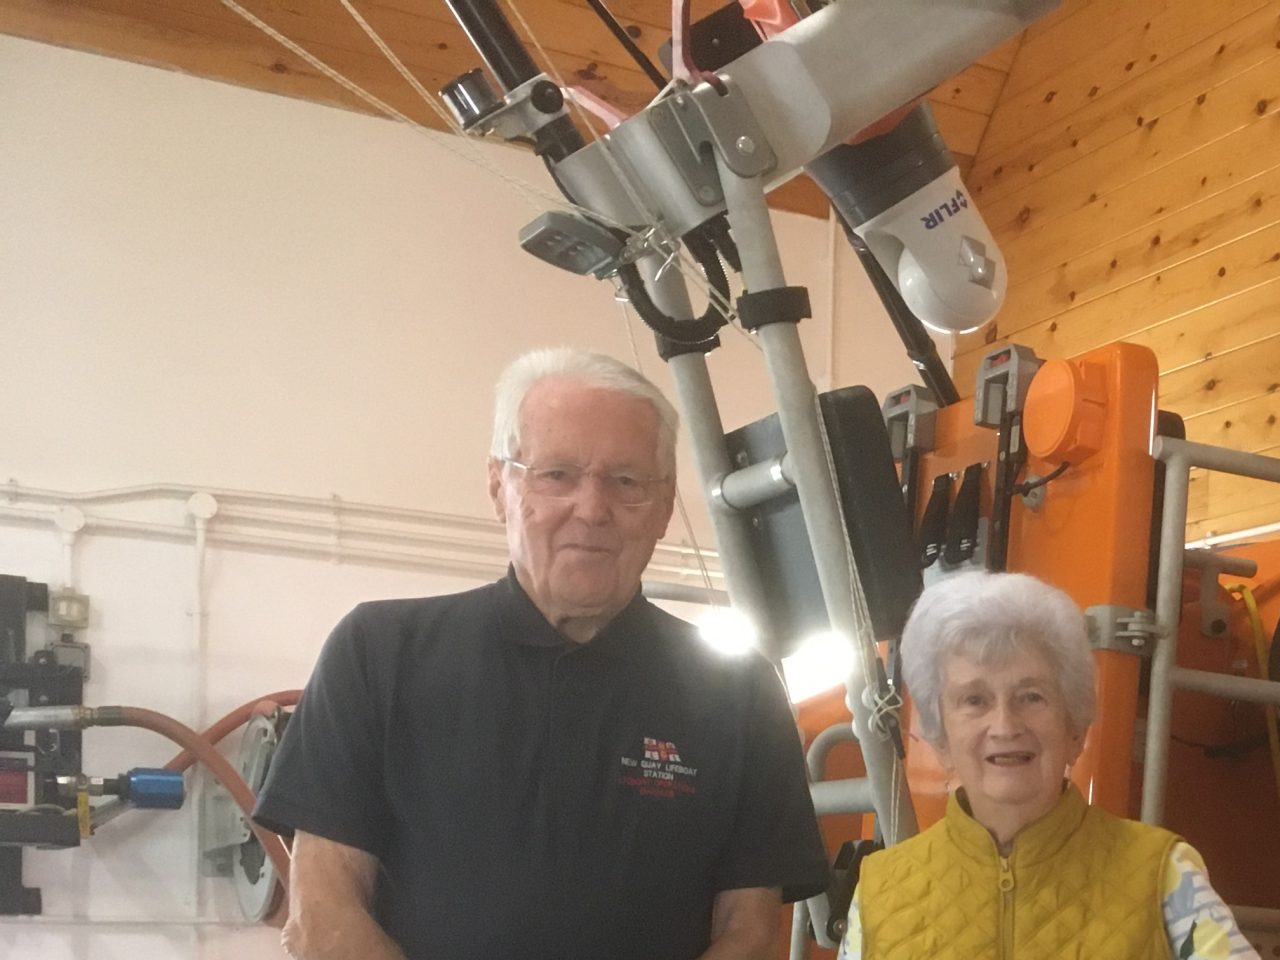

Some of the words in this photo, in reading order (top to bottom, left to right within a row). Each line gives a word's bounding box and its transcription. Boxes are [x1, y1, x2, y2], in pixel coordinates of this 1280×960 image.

[920, 197, 961, 230] FLIR
[621, 757, 638, 767] NEW
[641, 760, 661, 770] QUAY
[665, 764, 698, 776] LIFEBOAT
[643, 769, 674, 781] STATION
